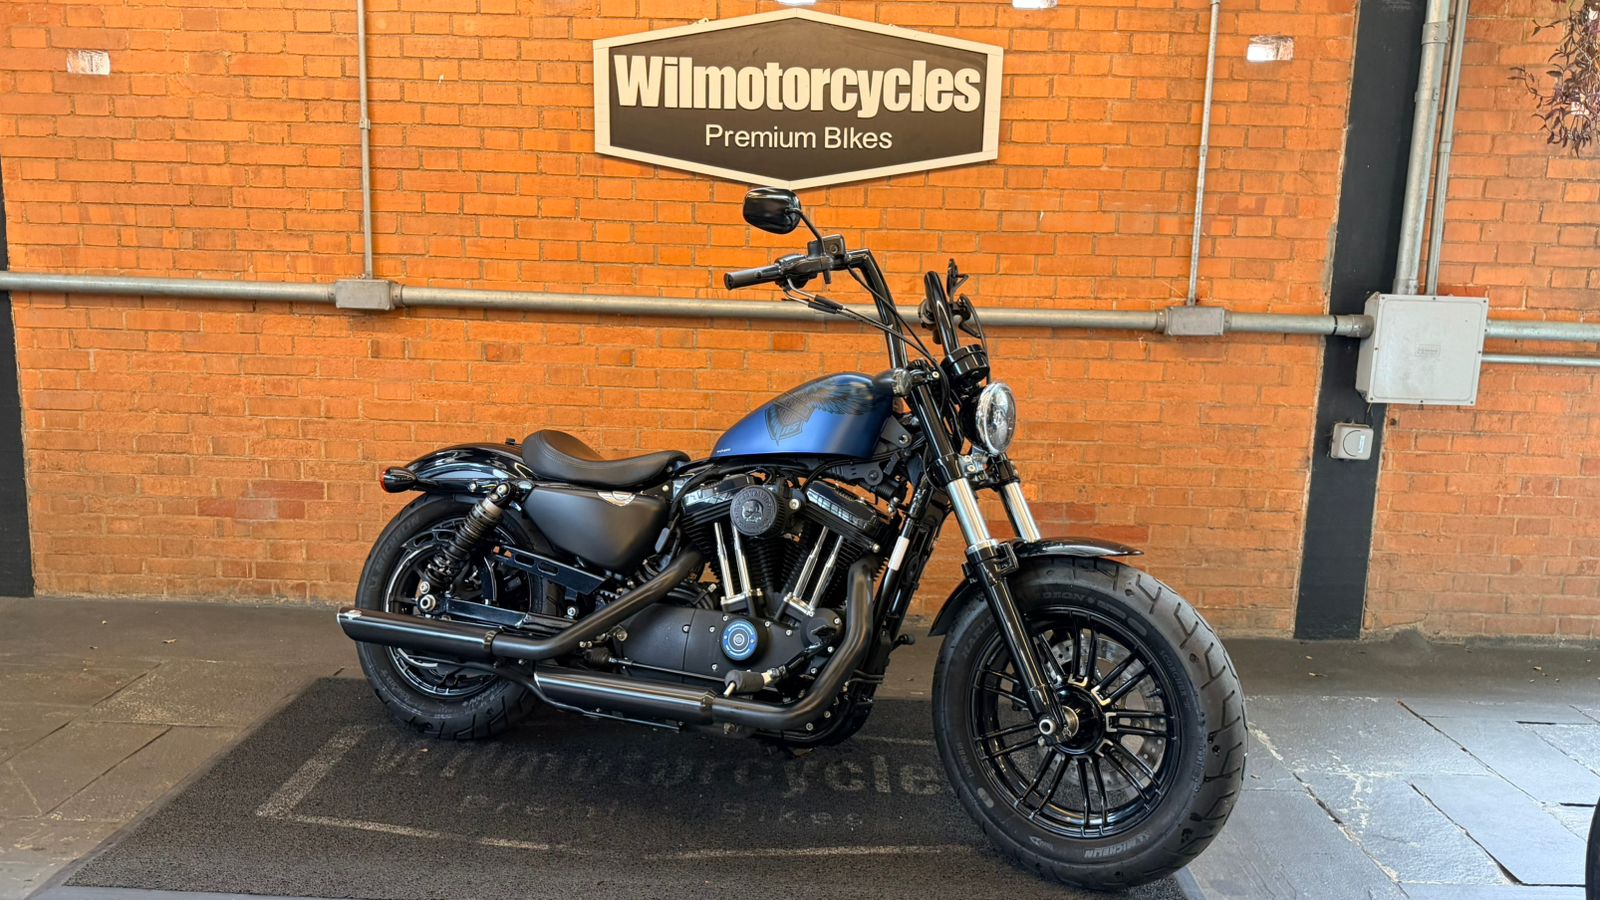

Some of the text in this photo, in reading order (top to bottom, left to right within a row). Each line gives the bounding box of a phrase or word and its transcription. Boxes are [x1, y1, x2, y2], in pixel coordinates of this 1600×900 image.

[613, 54, 982, 118] Wilmotorcycles
[705, 124, 817, 148] Premium
[1083, 839, 1138, 858] MICHELIN
